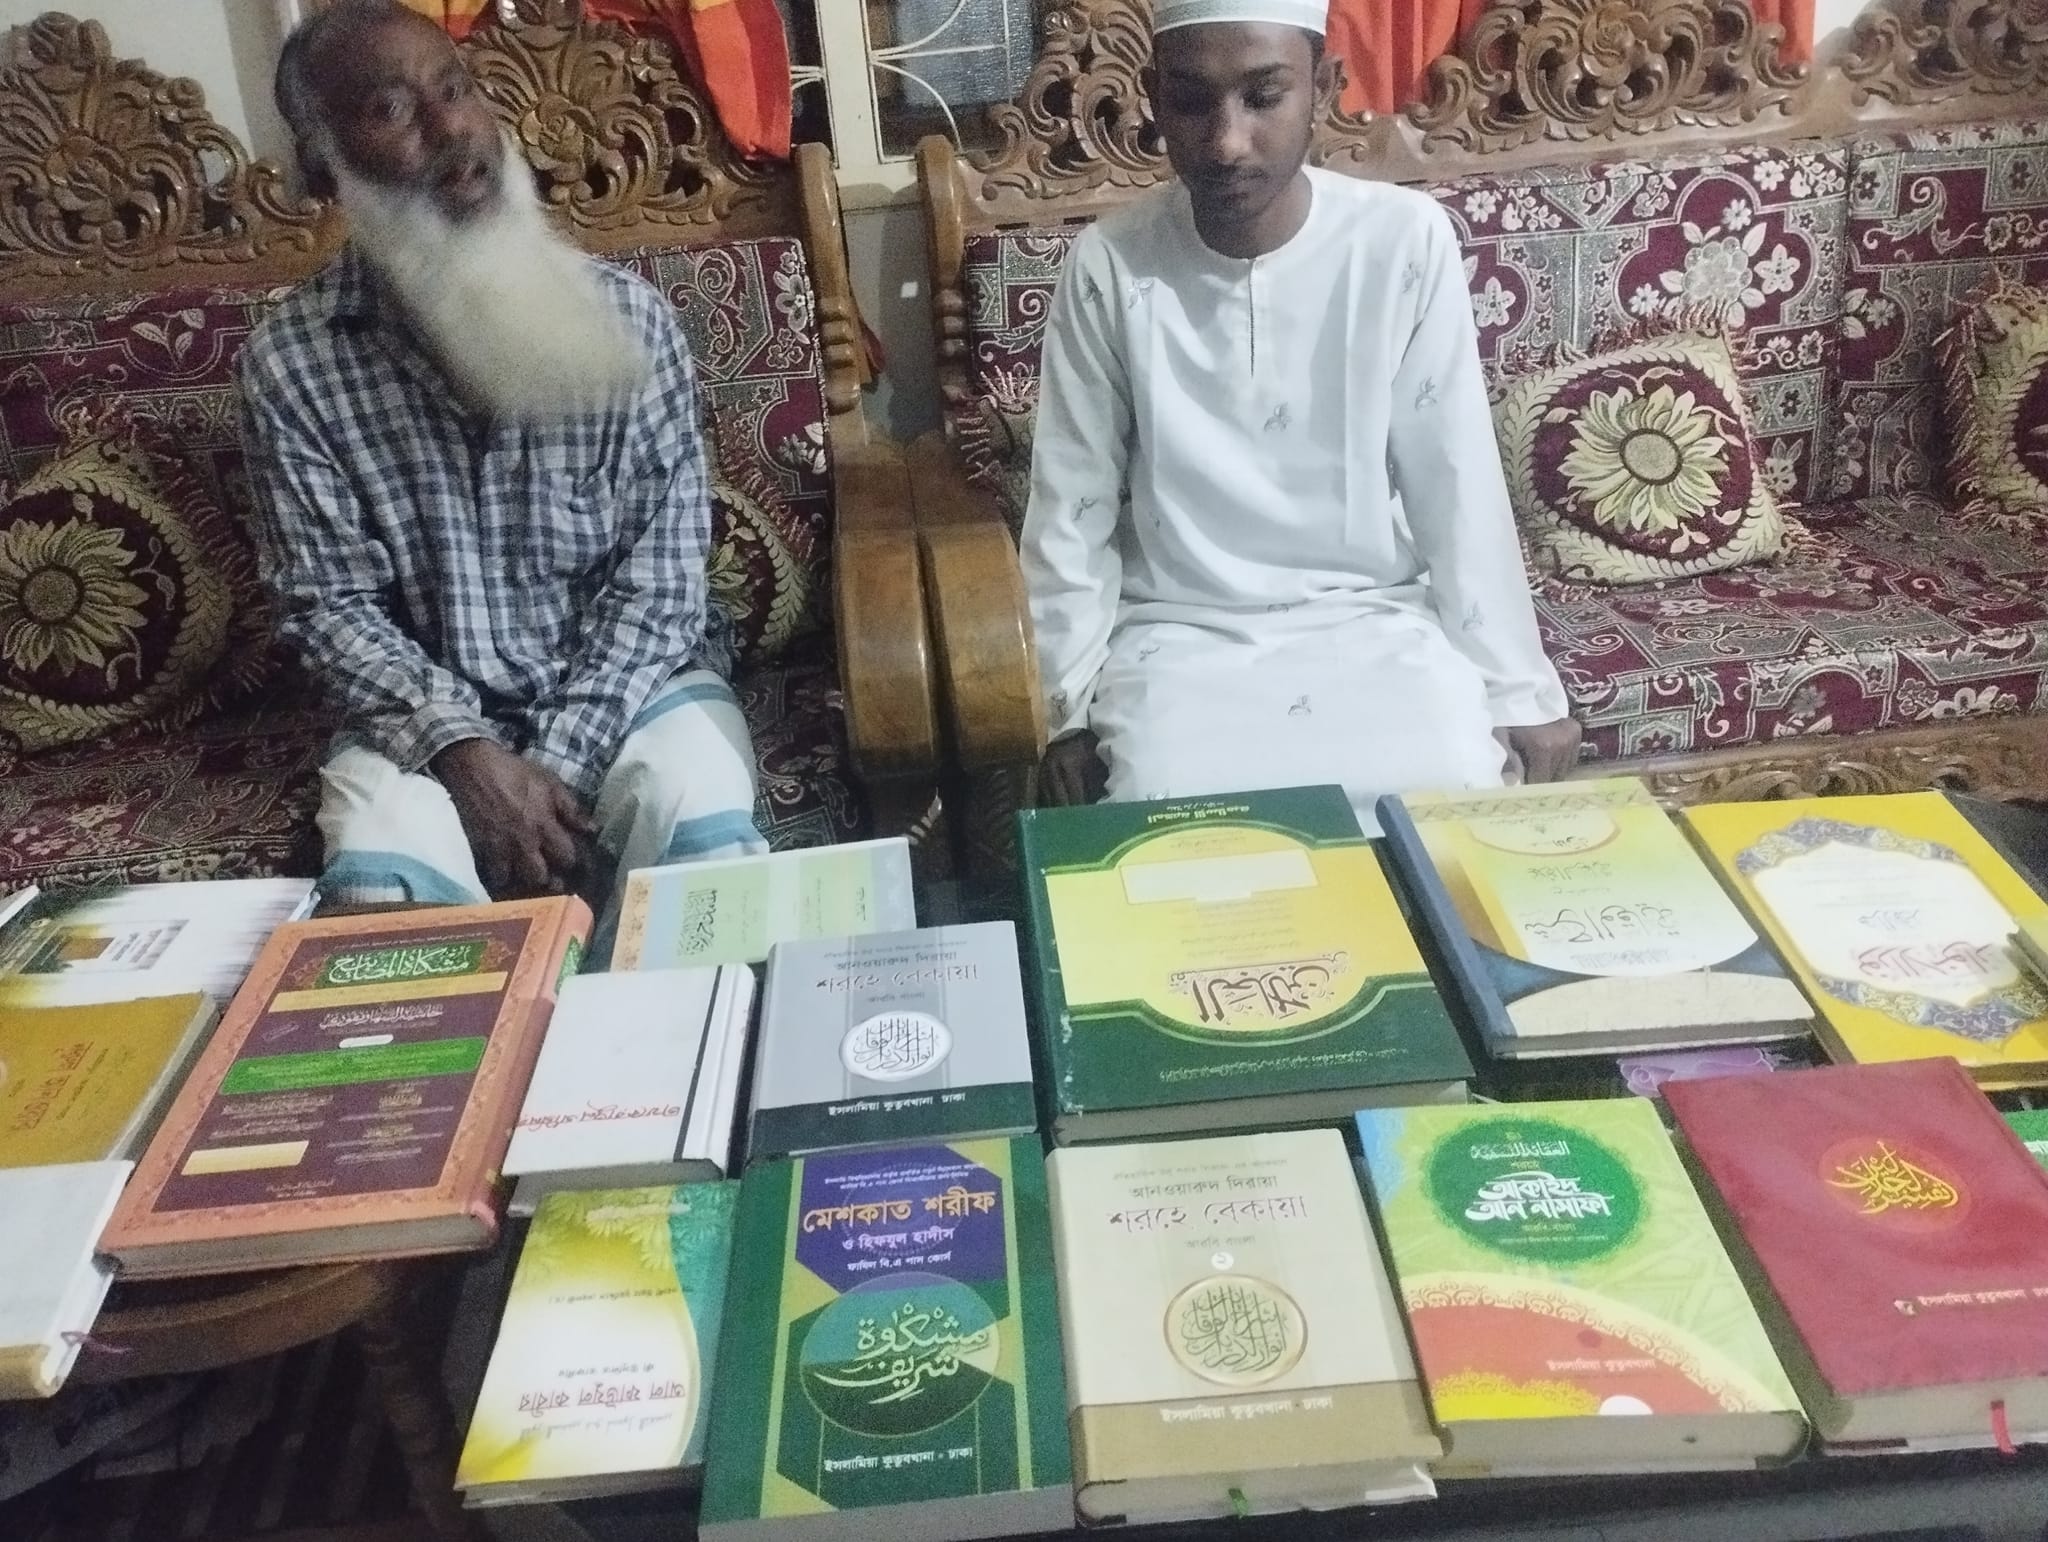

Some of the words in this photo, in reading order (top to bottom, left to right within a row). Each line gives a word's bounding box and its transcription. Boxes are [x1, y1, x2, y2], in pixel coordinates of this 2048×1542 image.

[1130, 1181, 1220, 1199] আনওয়ারুদ
[1226, 1174, 1278, 1191] দিরায়া
[802, 1198, 914, 1233] মেশকাত
[922, 1185, 996, 1219] শরীফ
[1109, 1205, 1187, 1233] শরহে
[1204, 1195, 1308, 1225] বেকায়া
[842, 1238, 853, 1251] ও
